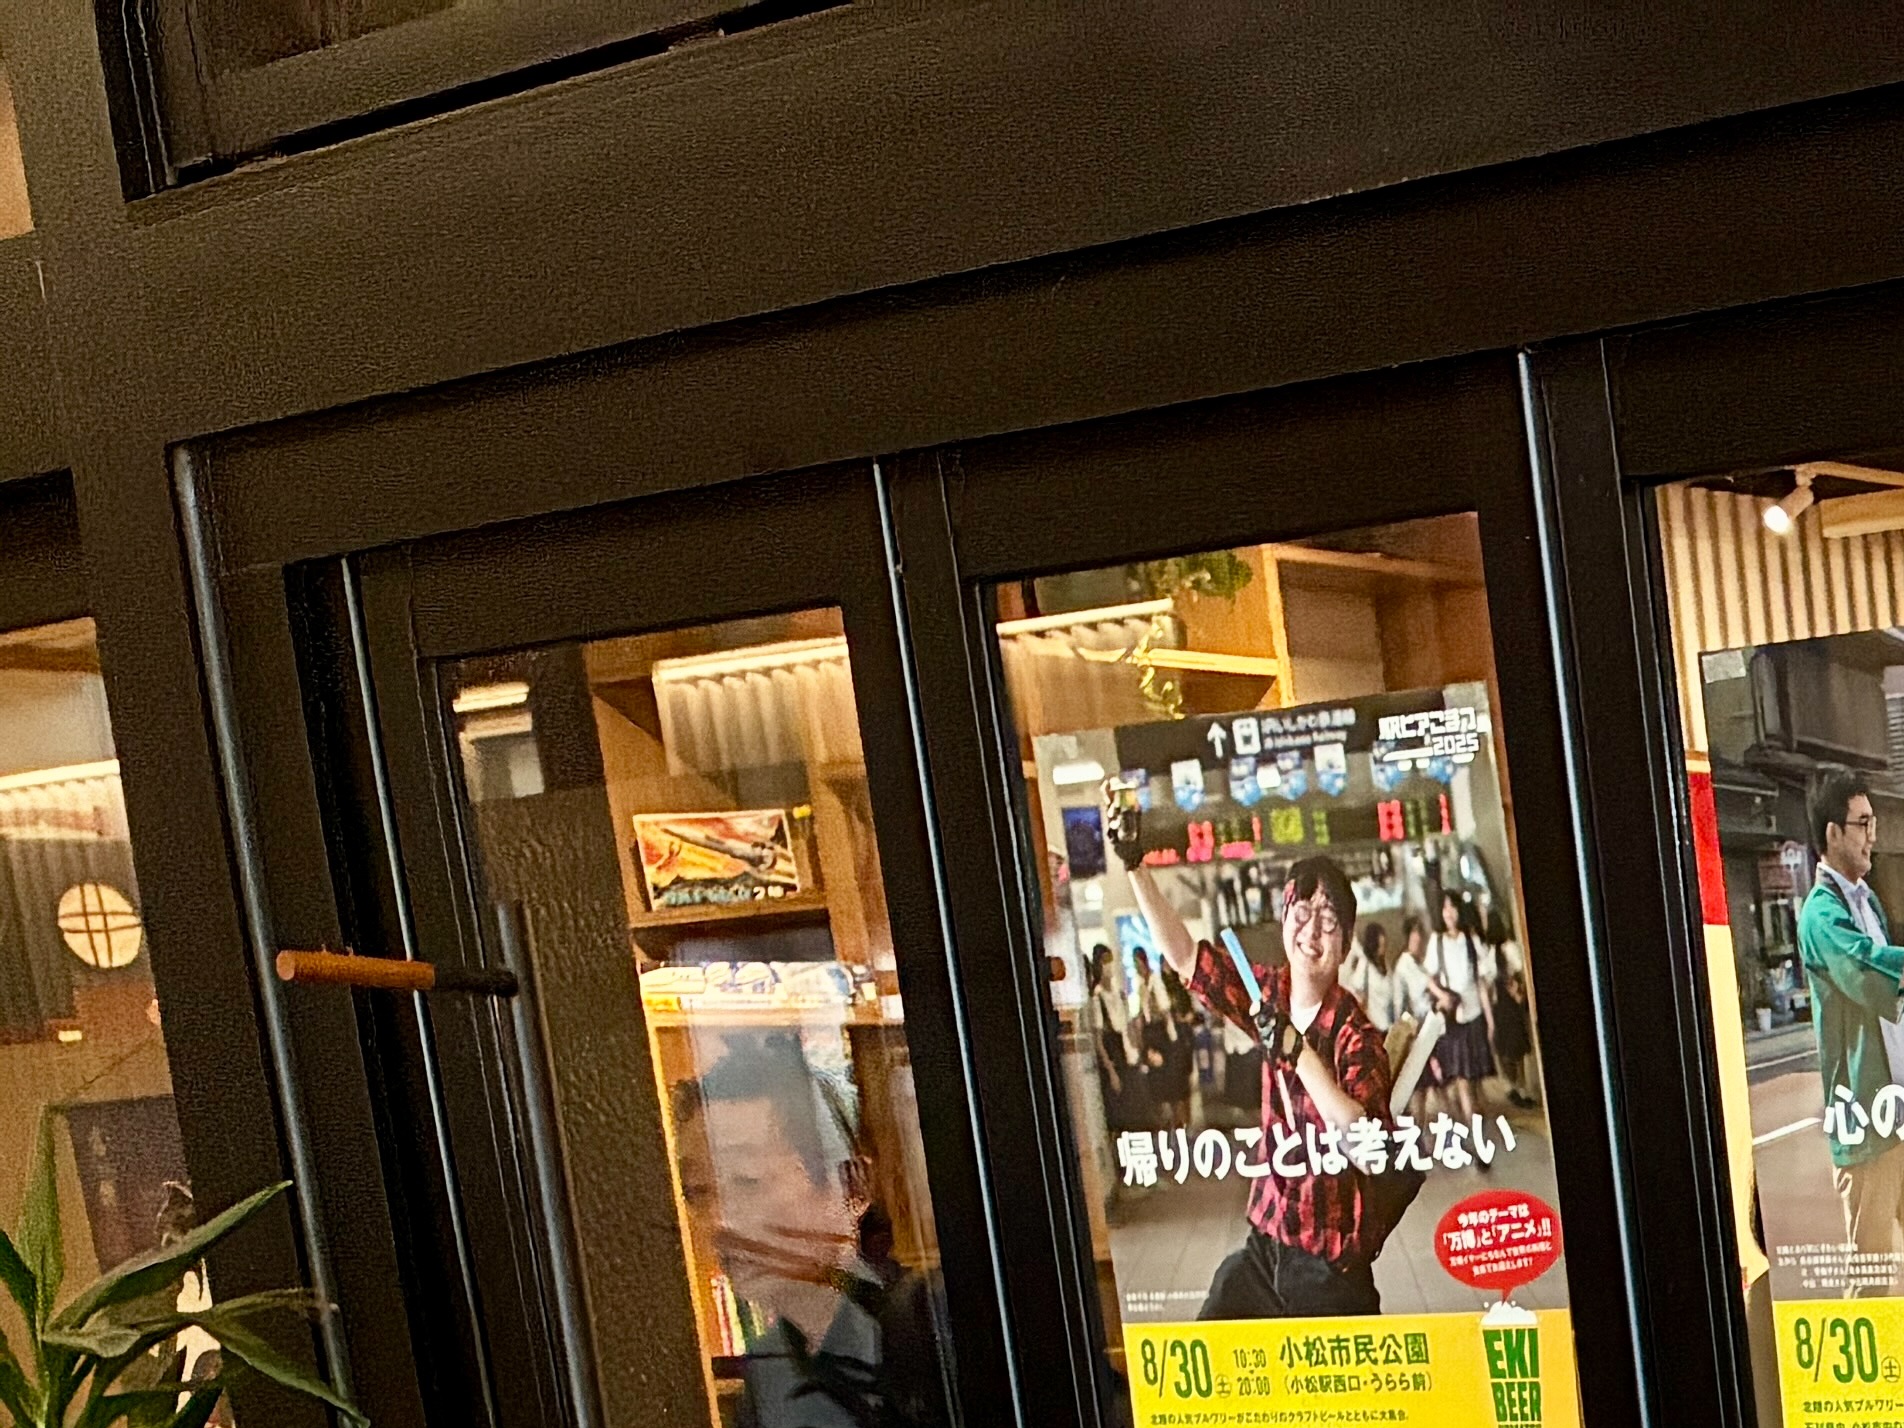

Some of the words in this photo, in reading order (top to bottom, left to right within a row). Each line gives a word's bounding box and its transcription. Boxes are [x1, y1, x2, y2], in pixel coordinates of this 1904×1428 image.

[1433, 733, 1479, 756] 2025
[1117, 1113, 1516, 1186] 帰りのことは考えない
[1457, 1203, 1530, 1227] 今年のテーマは
[1141, 1338, 1212, 1398] 8/30
[1233, 1349, 1267, 1368] 10:30
[1280, 1333, 1430, 1368] 小松市民公園
[1483, 1328, 1540, 1379] EKI
[1795, 1317, 1878, 1383] 8/30
[1237, 1377, 1270, 1396] 20:00
[1491, 1381, 1542, 1422] BEER
